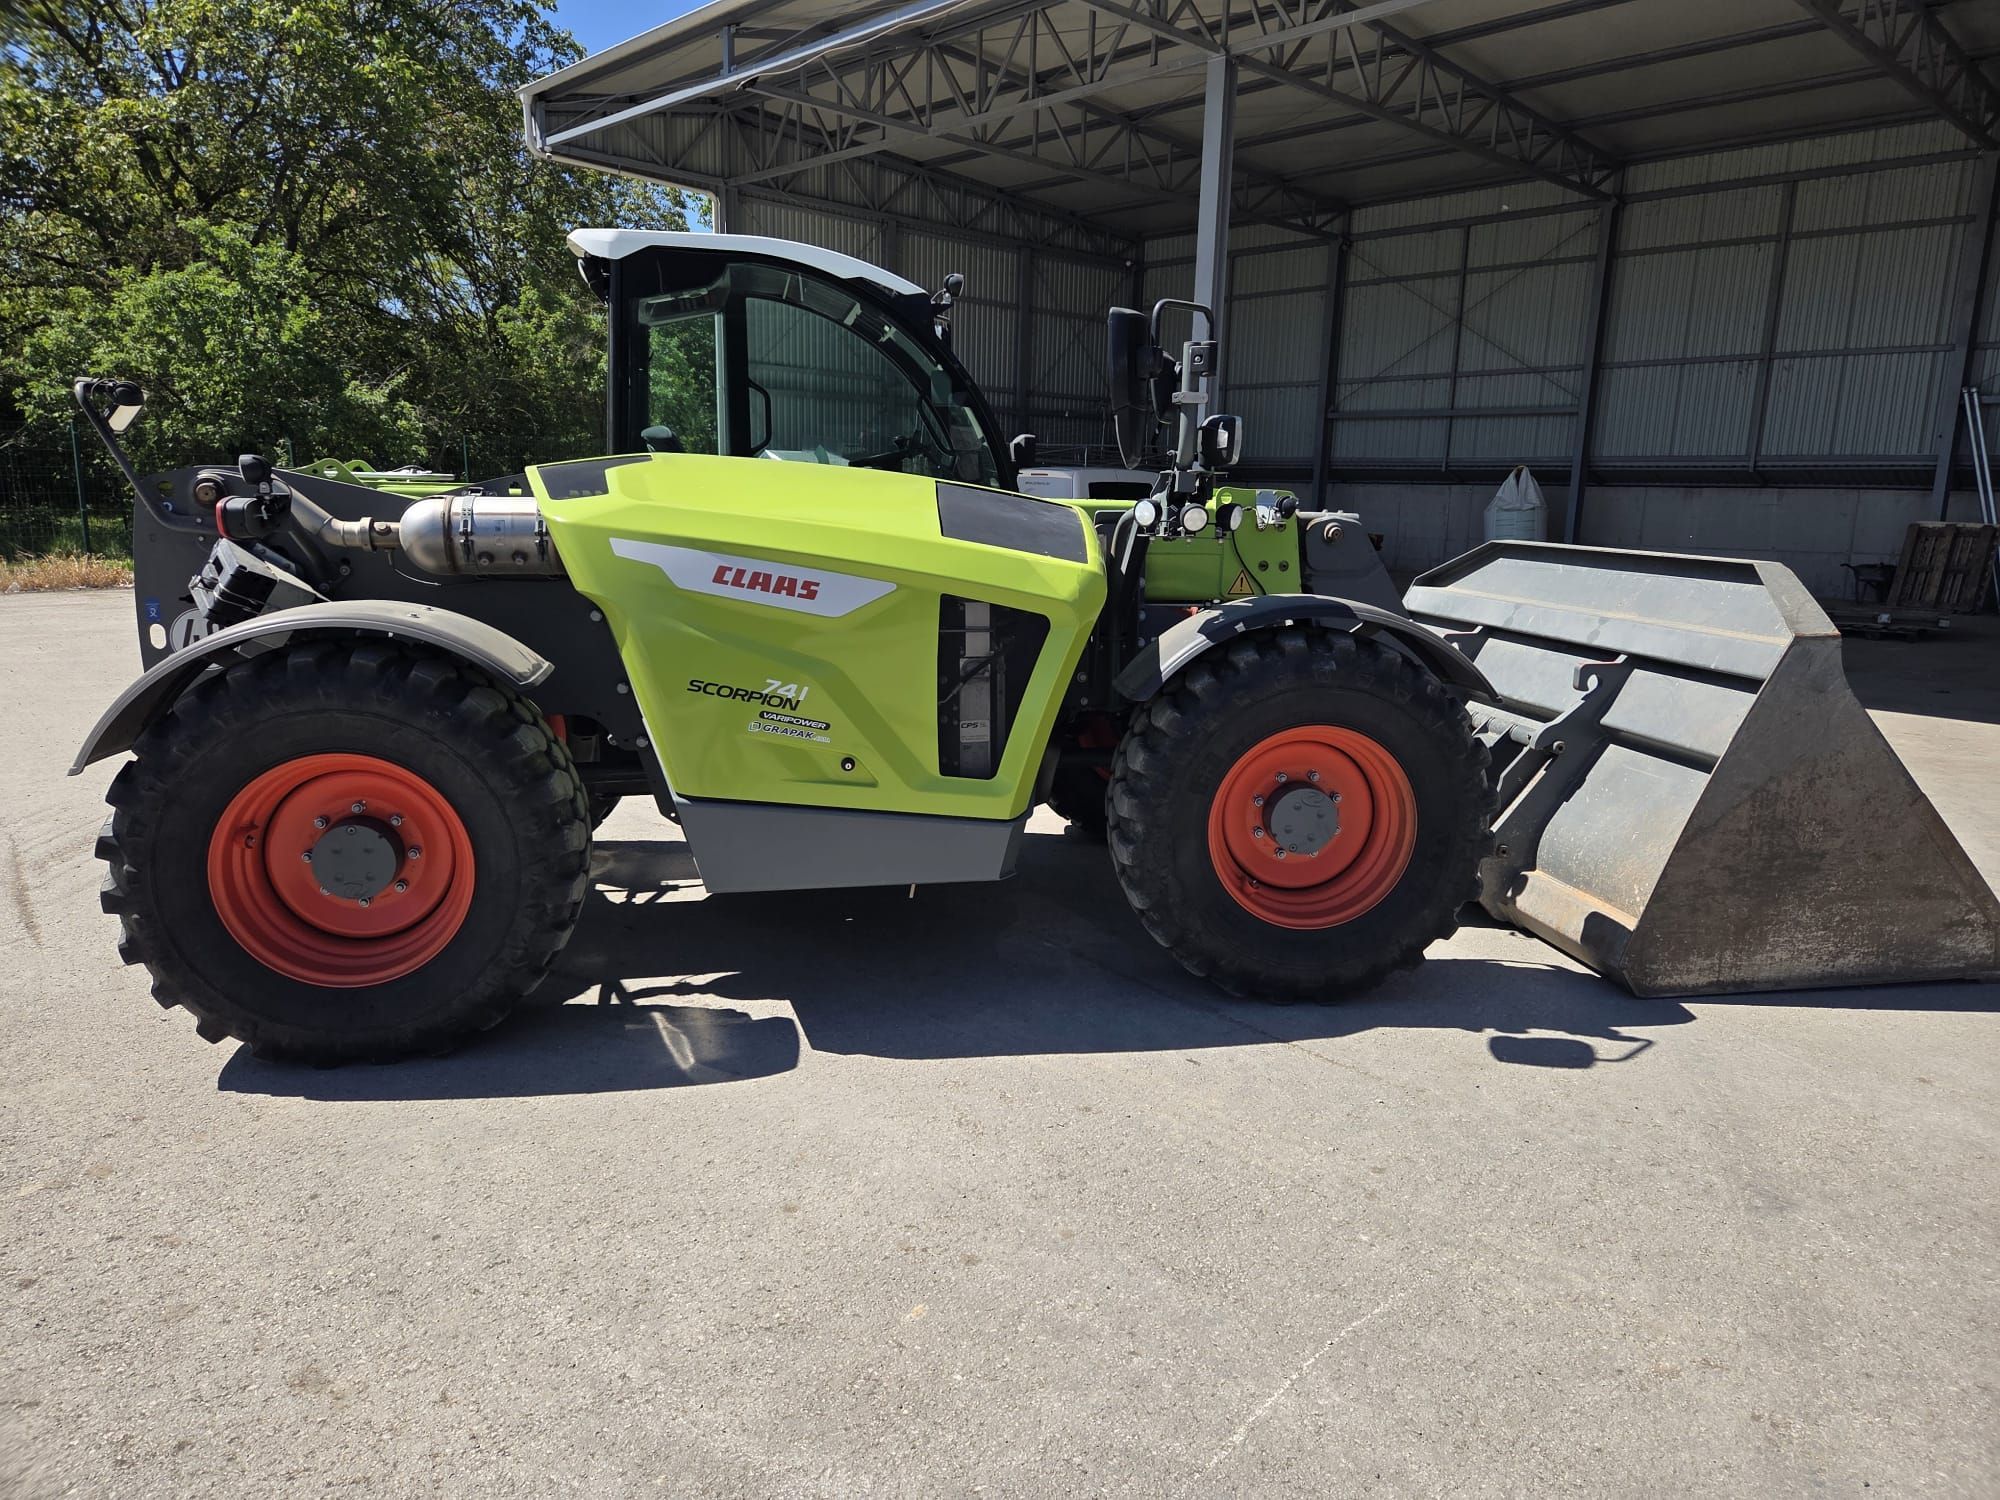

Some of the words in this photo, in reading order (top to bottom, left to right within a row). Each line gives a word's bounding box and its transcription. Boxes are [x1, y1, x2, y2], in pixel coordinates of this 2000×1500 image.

[712, 565, 821, 601] CLAAS
[686, 679, 801, 711] SCORPION
[759, 679, 809, 700] 741
[762, 711, 828, 730] VARIPOWER
